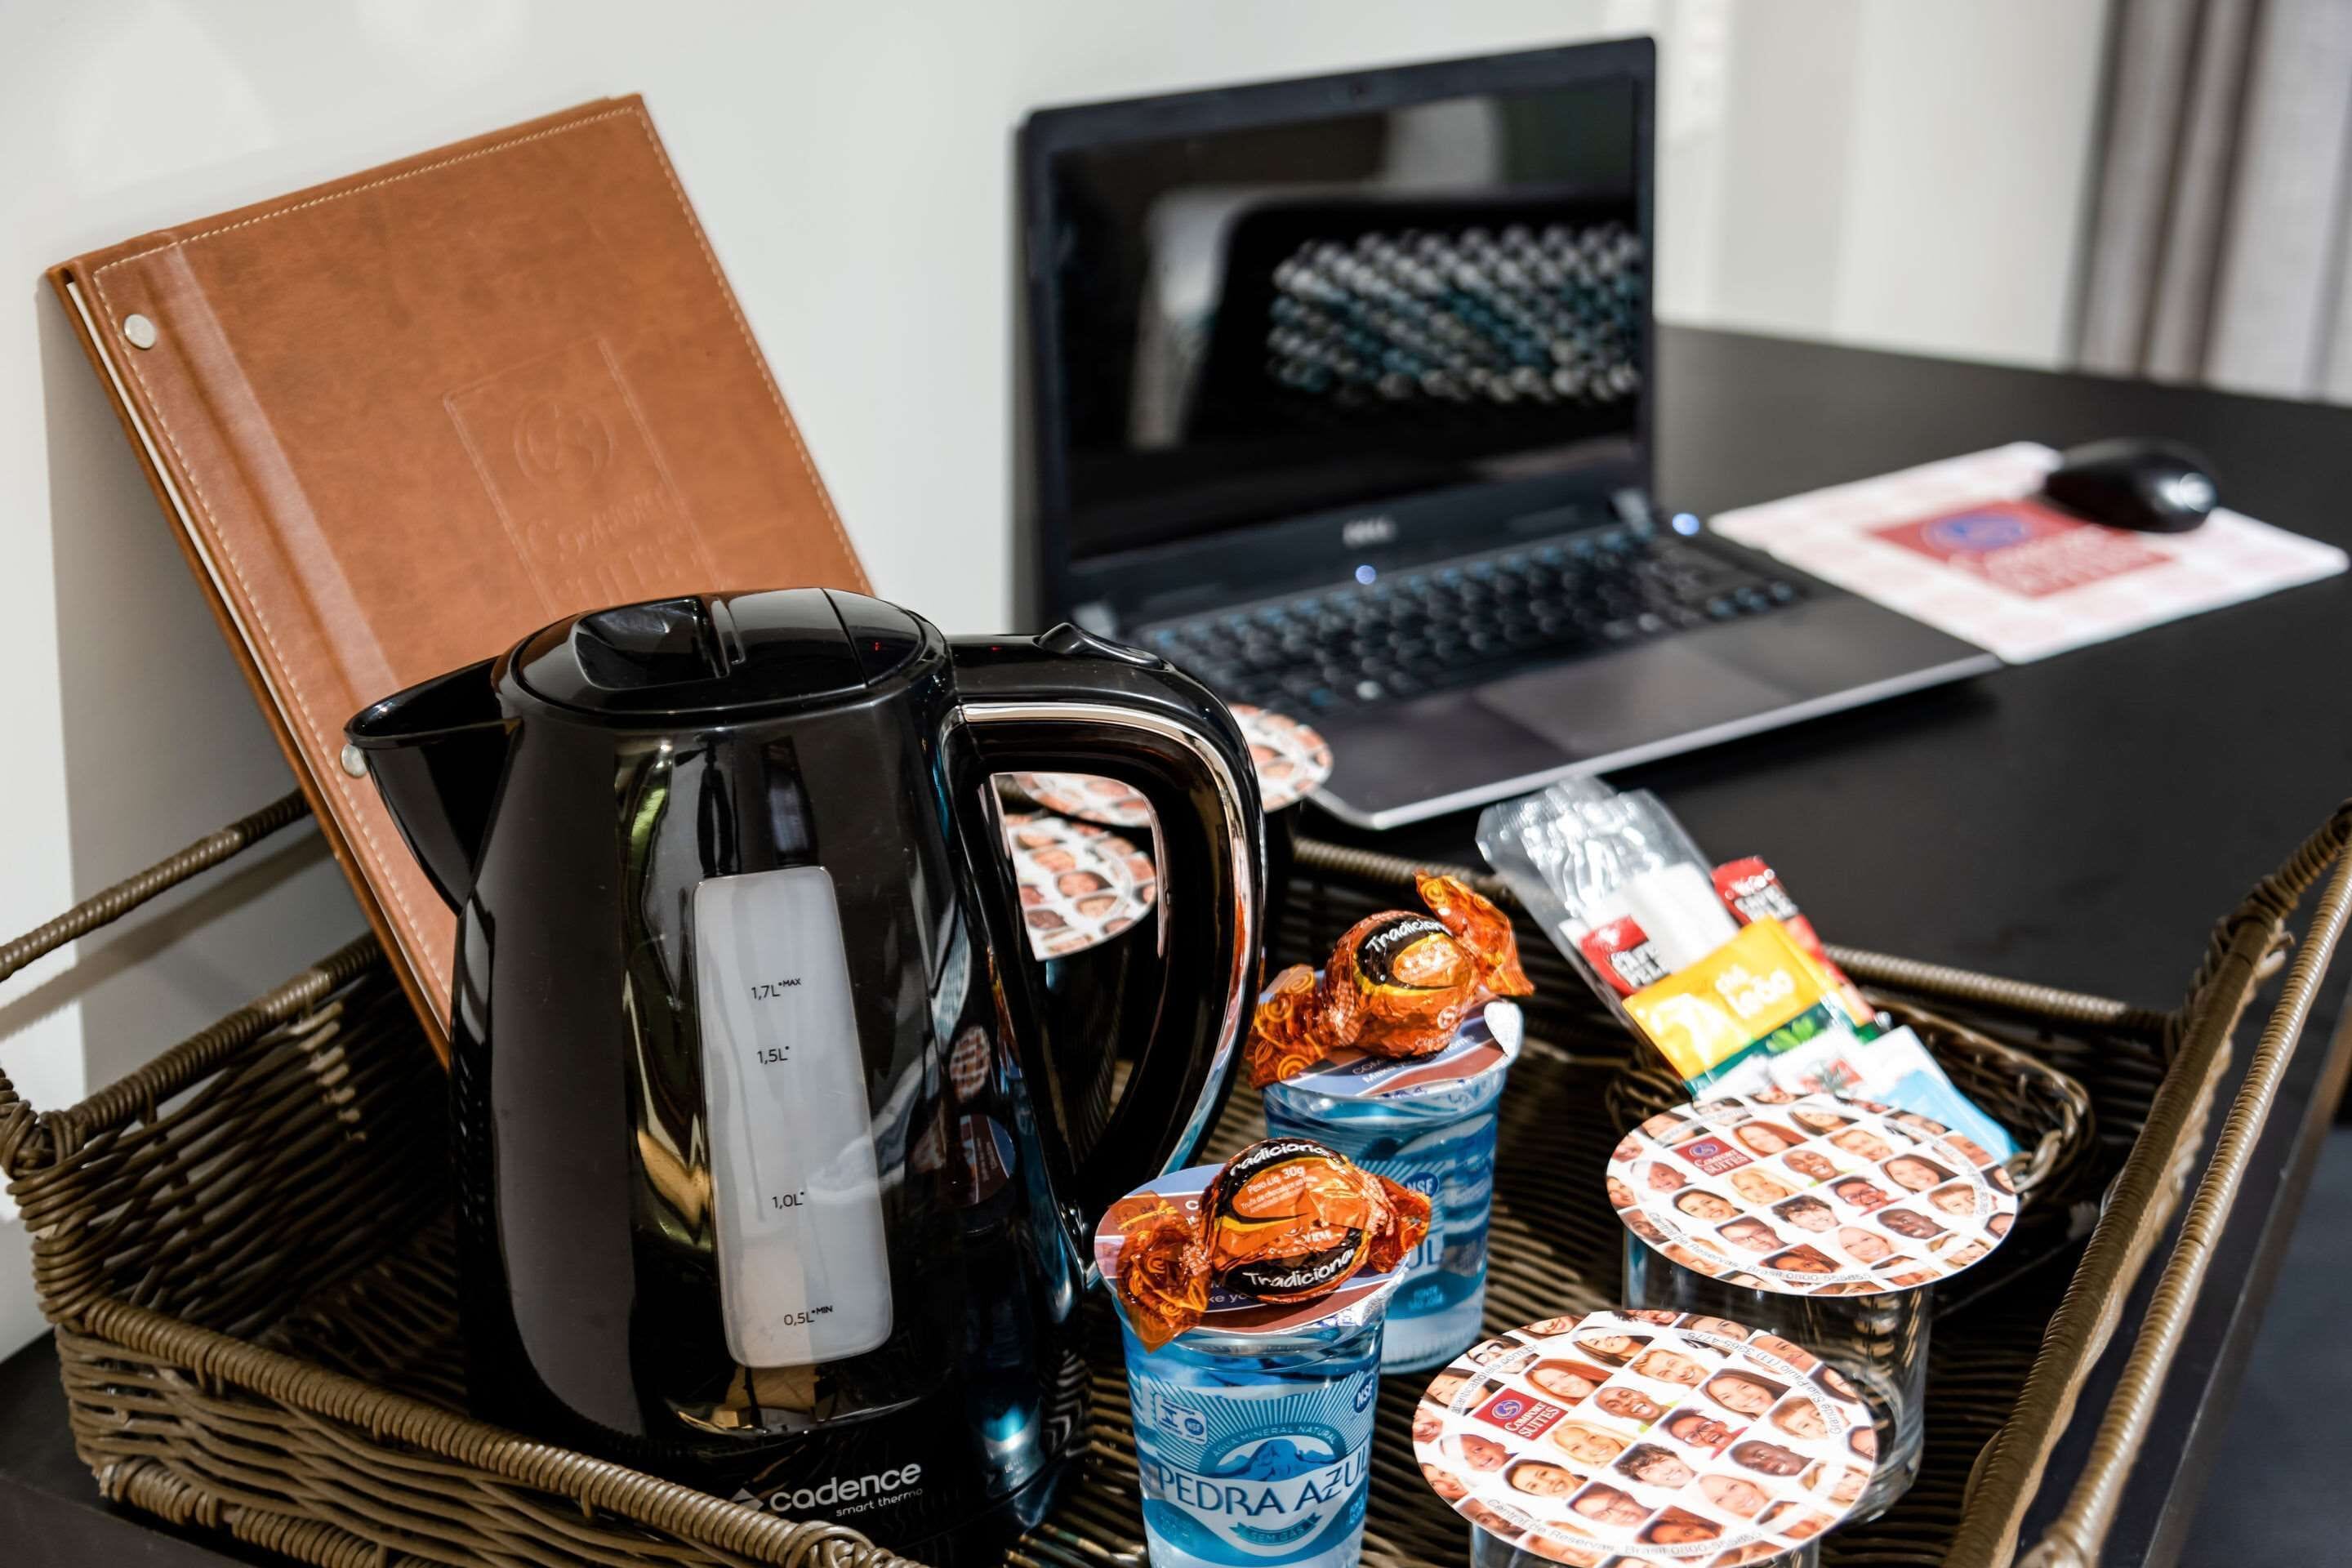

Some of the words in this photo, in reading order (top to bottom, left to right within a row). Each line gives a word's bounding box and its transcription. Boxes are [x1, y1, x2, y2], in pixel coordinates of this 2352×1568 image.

[751, 985, 780, 1001] 1,7L
[783, 978, 802, 987] MAX
[756, 1047, 787, 1064] 1,5L
[1281, 1165, 1307, 1179] 30g
[771, 1193, 804, 1210] 1,0L
[782, 1310, 815, 1327] 0,5L
[817, 1306, 833, 1316] MIN
[1517, 1406, 1560, 1437] SUITES
[1240, 1428, 1294, 1441] MINERAL
[1298, 1426, 1338, 1446] NATURAL
[769, 1463, 922, 1512] cadence
[1157, 1462, 1286, 1517] PEDRA
[1294, 1446, 1368, 1512] AZUL
[835, 1500, 875, 1517] smart
[877, 1487, 924, 1508] thermo
